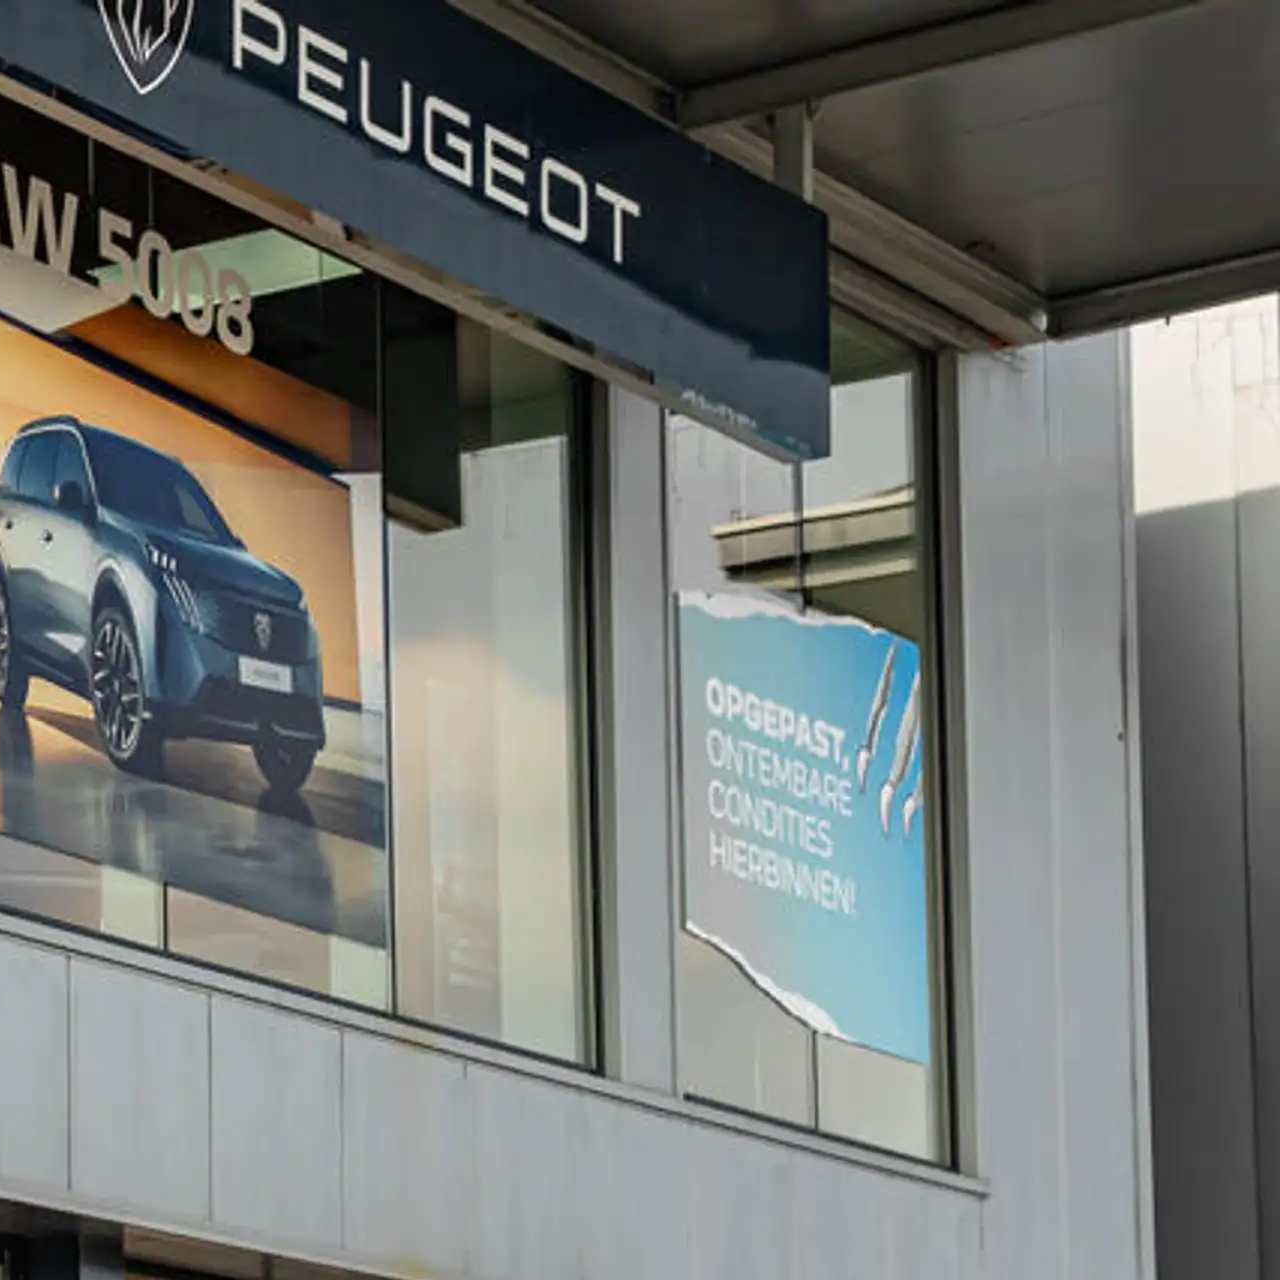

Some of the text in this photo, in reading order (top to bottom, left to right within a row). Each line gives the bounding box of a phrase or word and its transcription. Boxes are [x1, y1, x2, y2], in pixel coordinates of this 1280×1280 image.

[233, 0, 641, 265] PEUGEOT
[96, 205, 255, 356] 5008
[705, 676, 850, 771] OPGEPAST,
[705, 728, 853, 818] ONTEMBARE
[707, 779, 834, 859] CONDITIES
[709, 828, 857, 916] HIERBINNEN!
